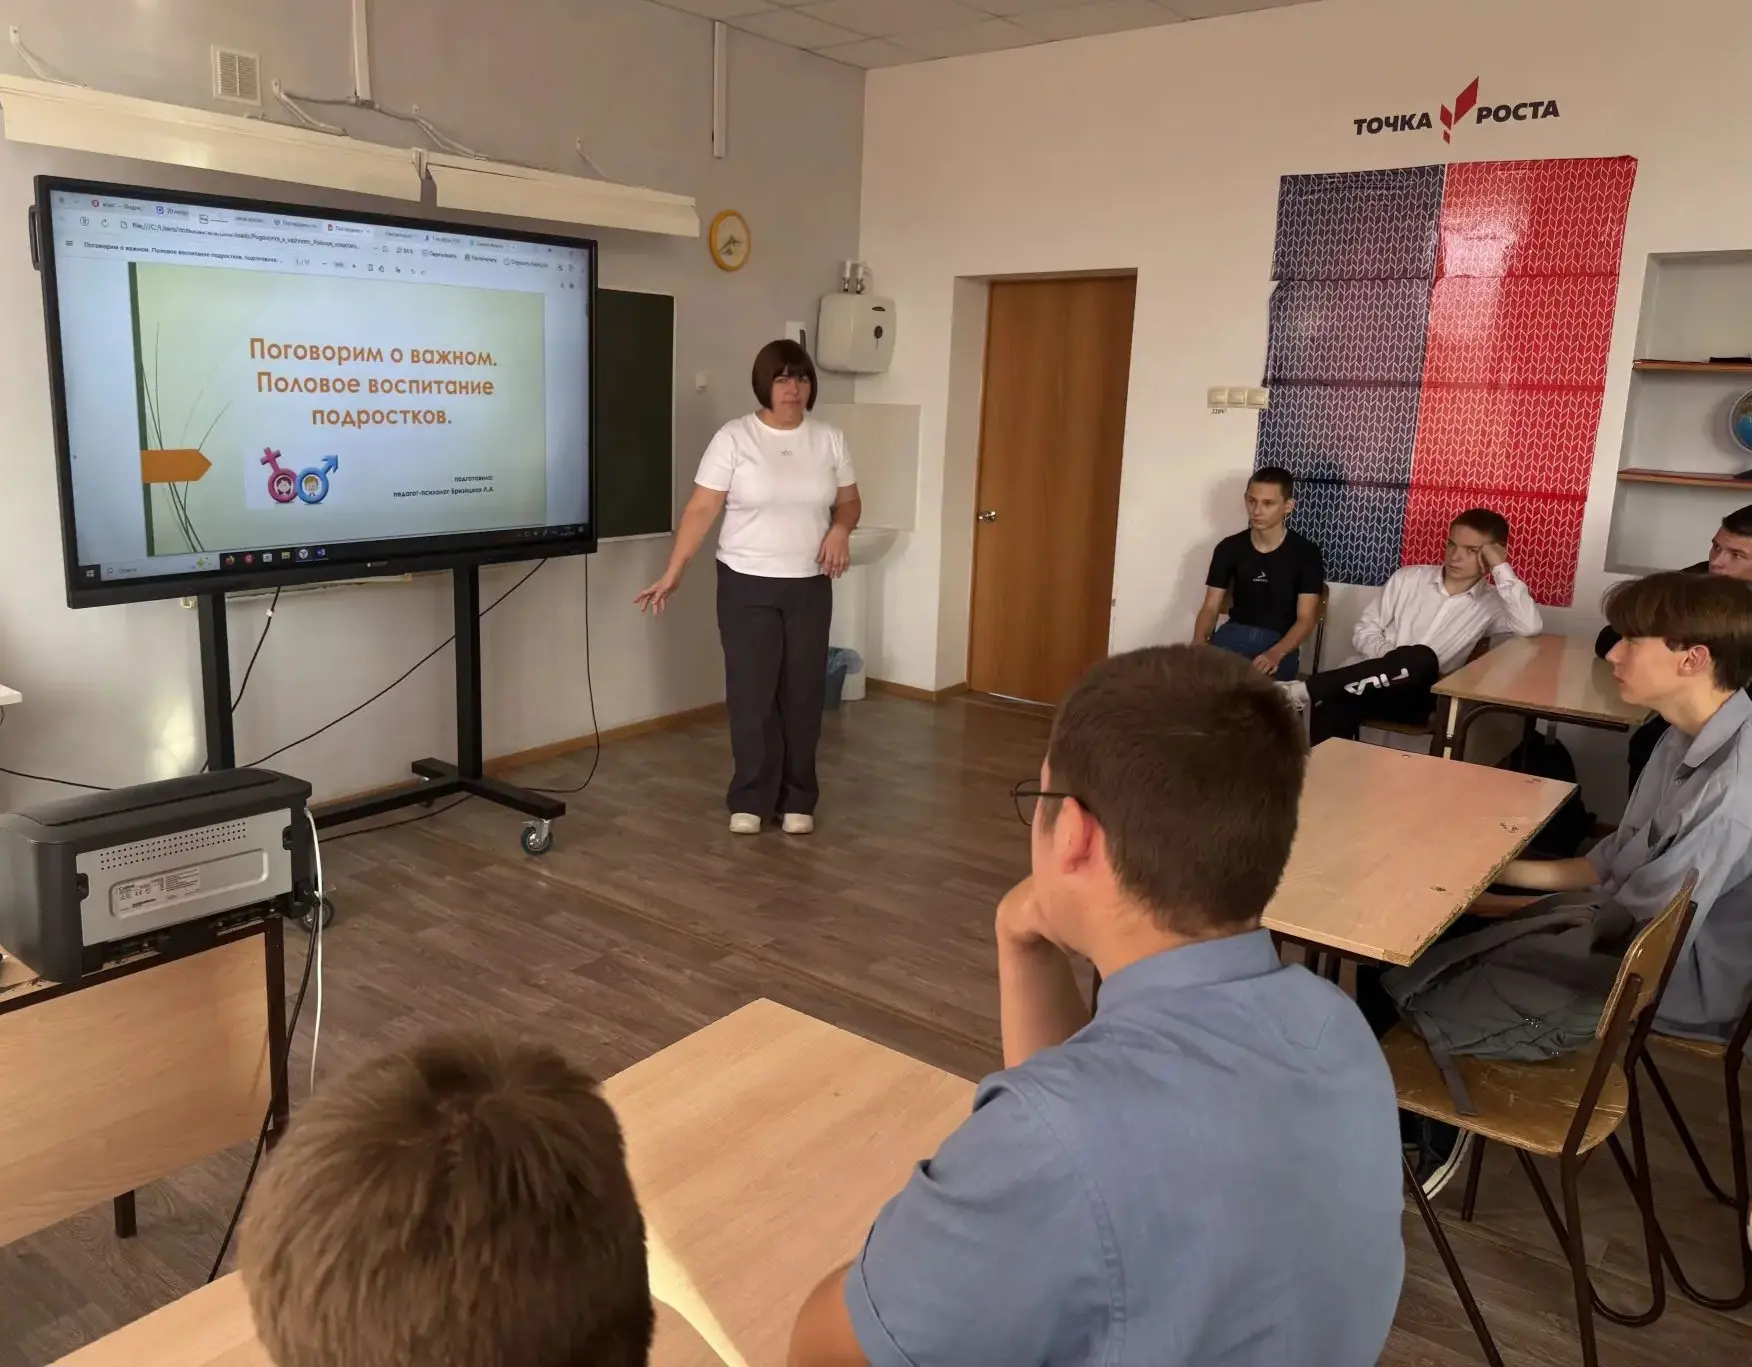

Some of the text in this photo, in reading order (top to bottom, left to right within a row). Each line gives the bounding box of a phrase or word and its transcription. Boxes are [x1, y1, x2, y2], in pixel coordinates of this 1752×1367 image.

[1354, 100, 1560, 135] ТОЧКА РОСТА
[83, 241, 119, 251] Поговорим
[151, 247, 178, 255] Половое
[178, 250, 210, 258] воспитание
[250, 337, 498, 367] Поговорим о важном.
[257, 371, 494, 396] Половое воспитание
[312, 409, 452, 429] подростков.
[393, 489, 450, 498] педагог-психолог
